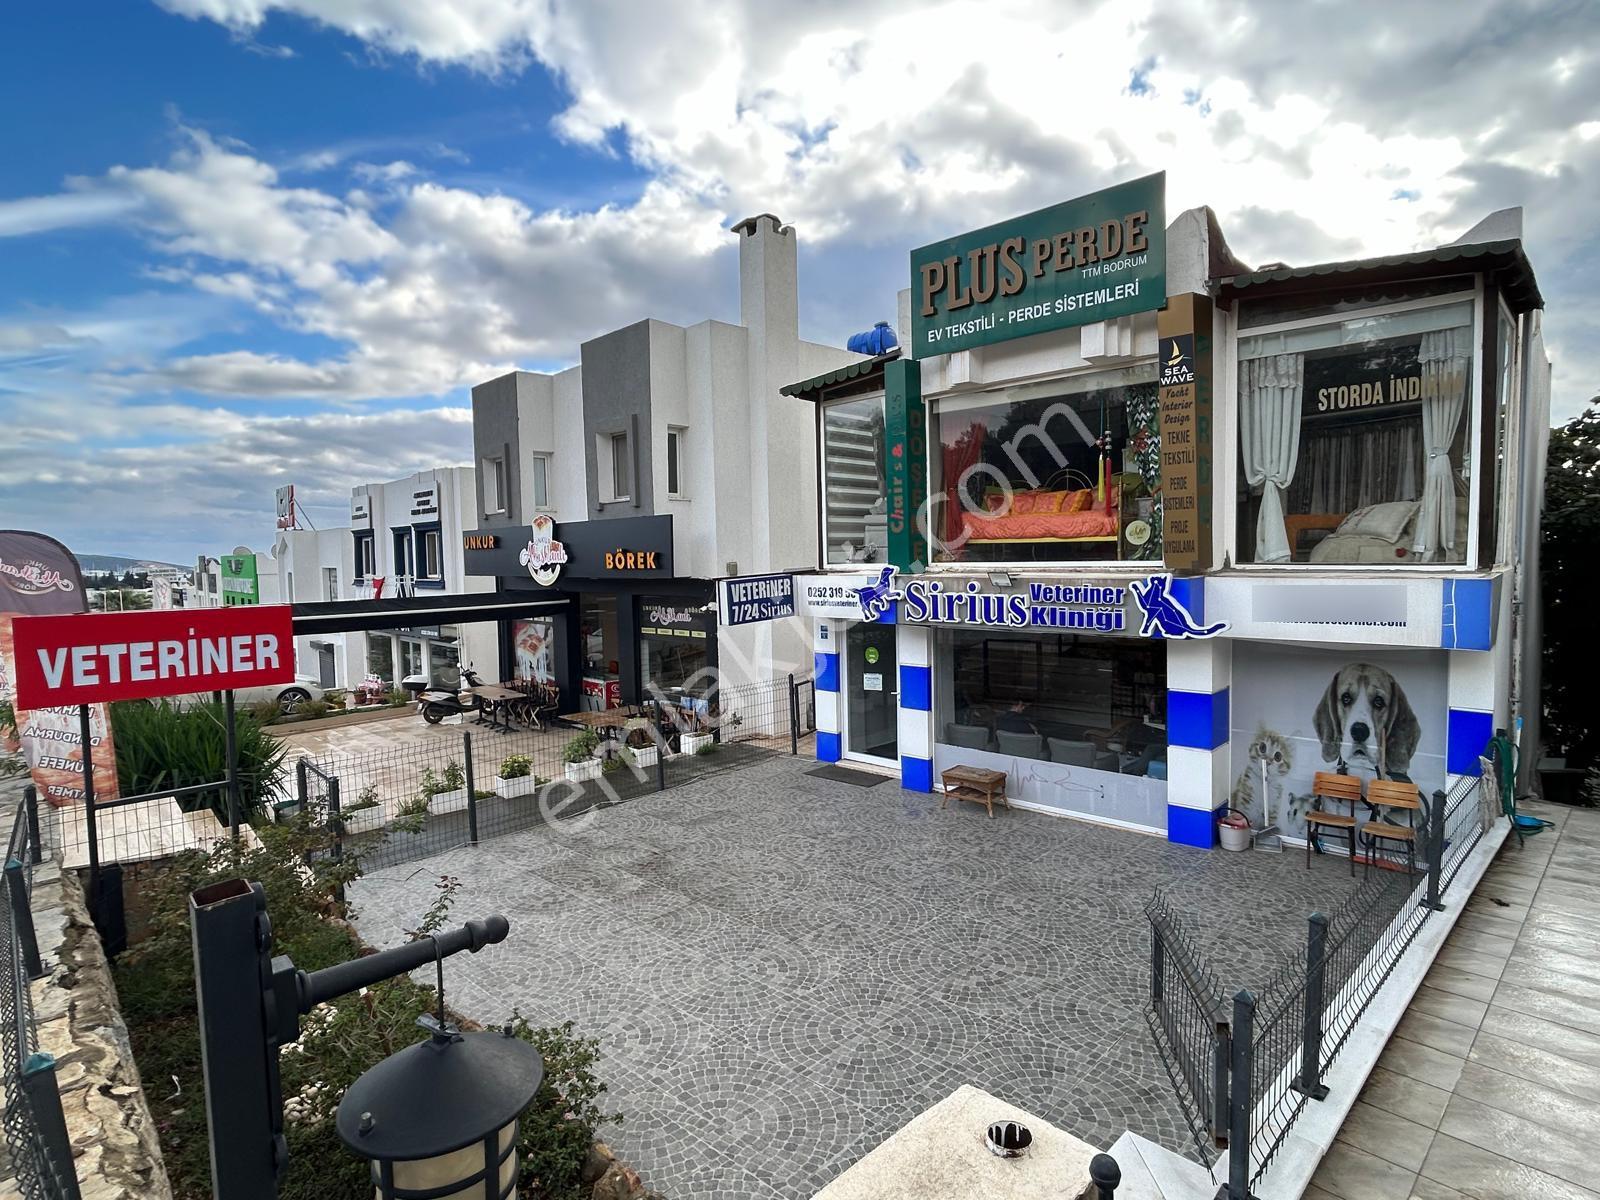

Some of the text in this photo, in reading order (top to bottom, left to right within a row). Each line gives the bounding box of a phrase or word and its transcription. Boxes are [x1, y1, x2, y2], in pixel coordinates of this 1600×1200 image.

[920, 209, 1150, 318] PLUS PERDE
[1081, 254, 1148, 280] TTM BODRUM
[927, 328, 943, 343] EV
[944, 312, 996, 339] TEKSTİLİ
[1008, 301, 1052, 325] PERDE
[1054, 278, 1140, 314] SİSTEMLERİ
[1160, 372, 1194, 385] WAVE
[1163, 365, 1189, 376] SEA
[1165, 386, 1190, 399] Yacht
[1317, 381, 1384, 412] STORDA
[1162, 399, 1194, 412] Interior
[1163, 412, 1191, 427] Design
[1166, 429, 1191, 445] TEKNE
[891, 442, 905, 458] &
[1169, 476, 1188, 491] PERDE
[1170, 520, 1189, 534] PROJE
[604, 548, 659, 570] BÖREK
[807, 586, 828, 599] 0252
[828, 587, 844, 600] 319
[1030, 583, 1126, 605] Veteriner
[731, 601, 793, 623] 7/24 Sirius
[904, 579, 1030, 628] Sirius
[1030, 606, 1127, 632] Kliniği
[37, 628, 280, 690] VETERİNER
